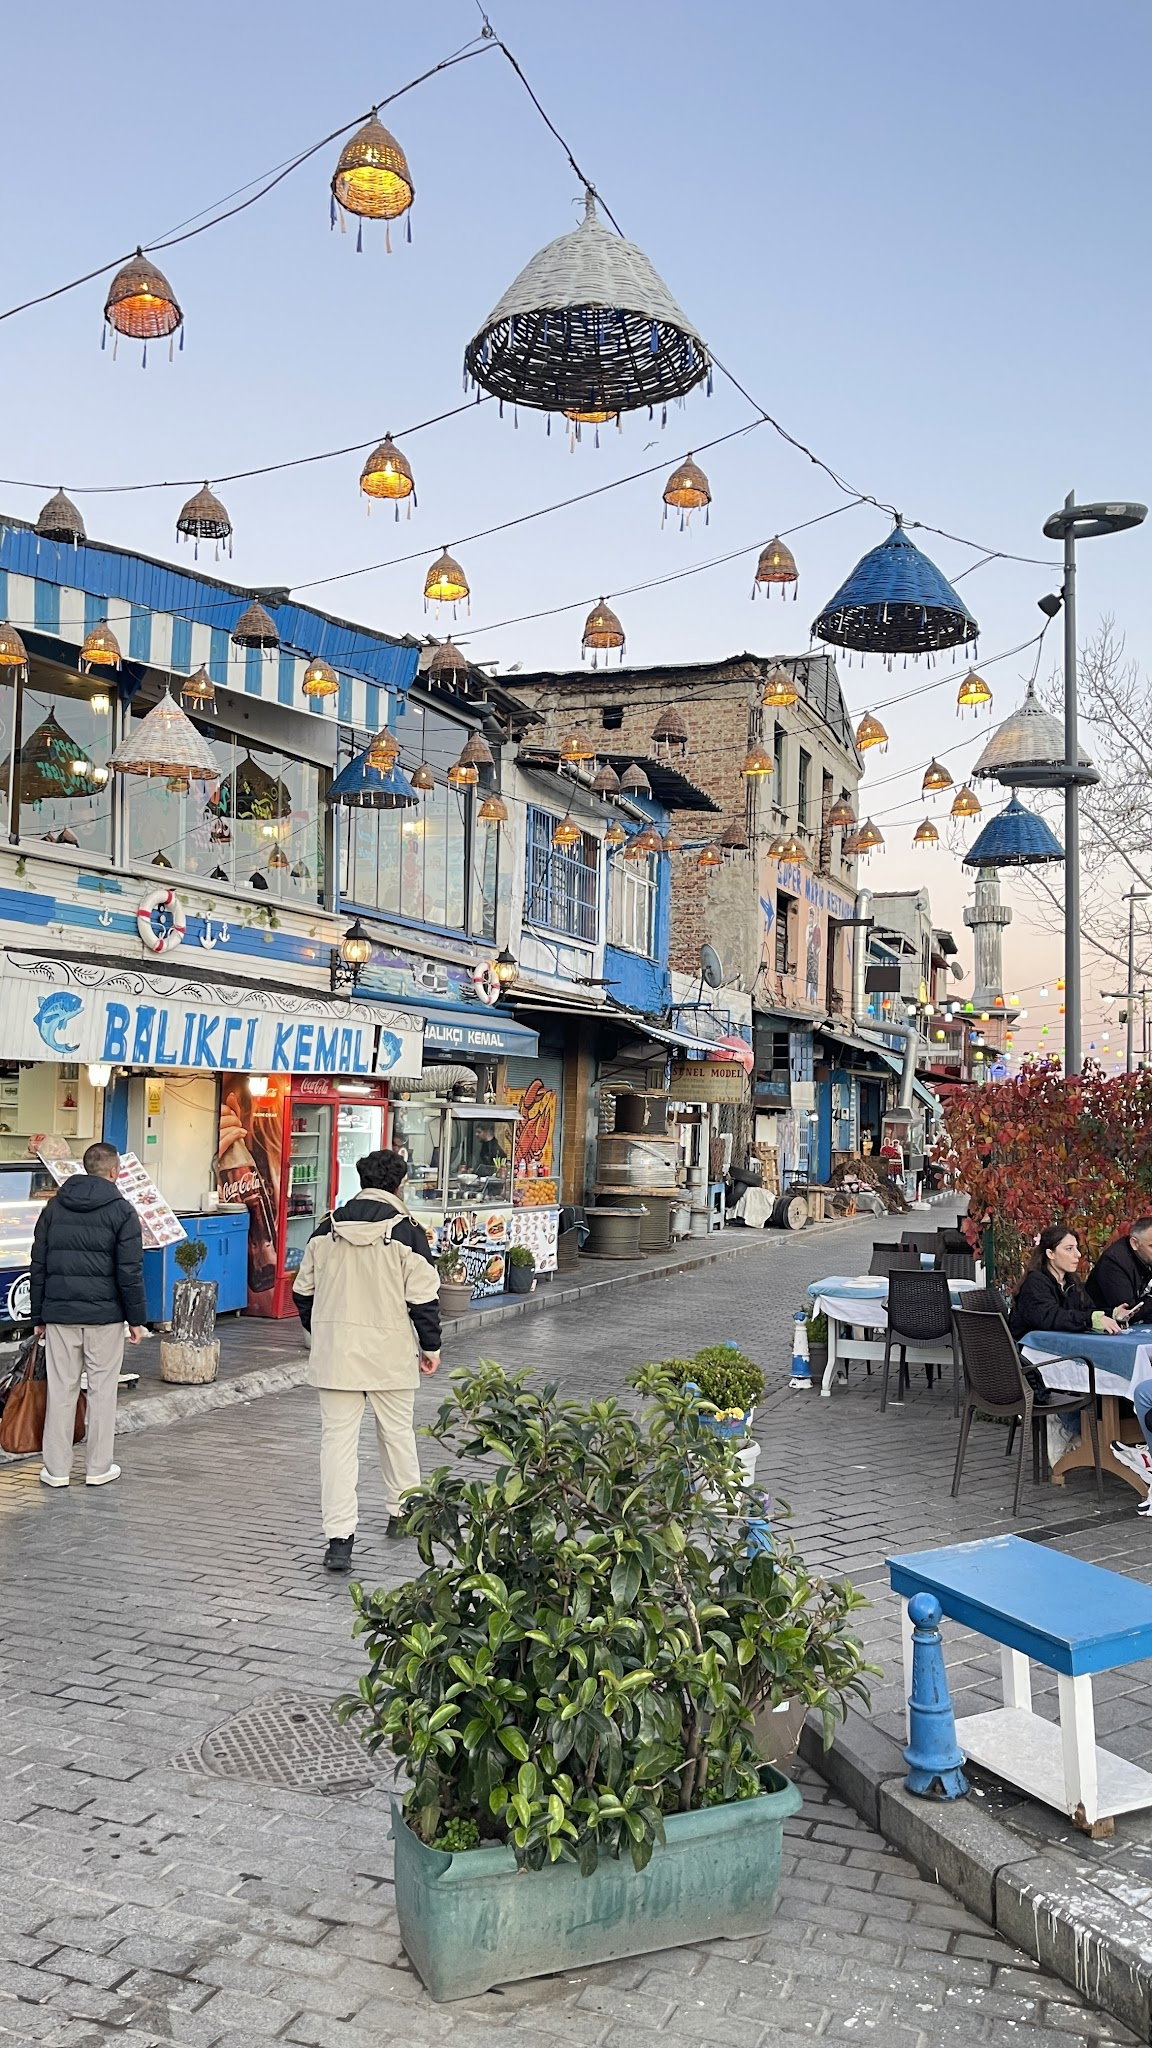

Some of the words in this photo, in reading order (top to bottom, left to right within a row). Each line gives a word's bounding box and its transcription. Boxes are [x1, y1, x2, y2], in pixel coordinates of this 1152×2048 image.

[272, 1021, 369, 1073] KEMAL
[468, 1030, 504, 1047] KEMAL
[711, 1069, 743, 1078] MODEL
